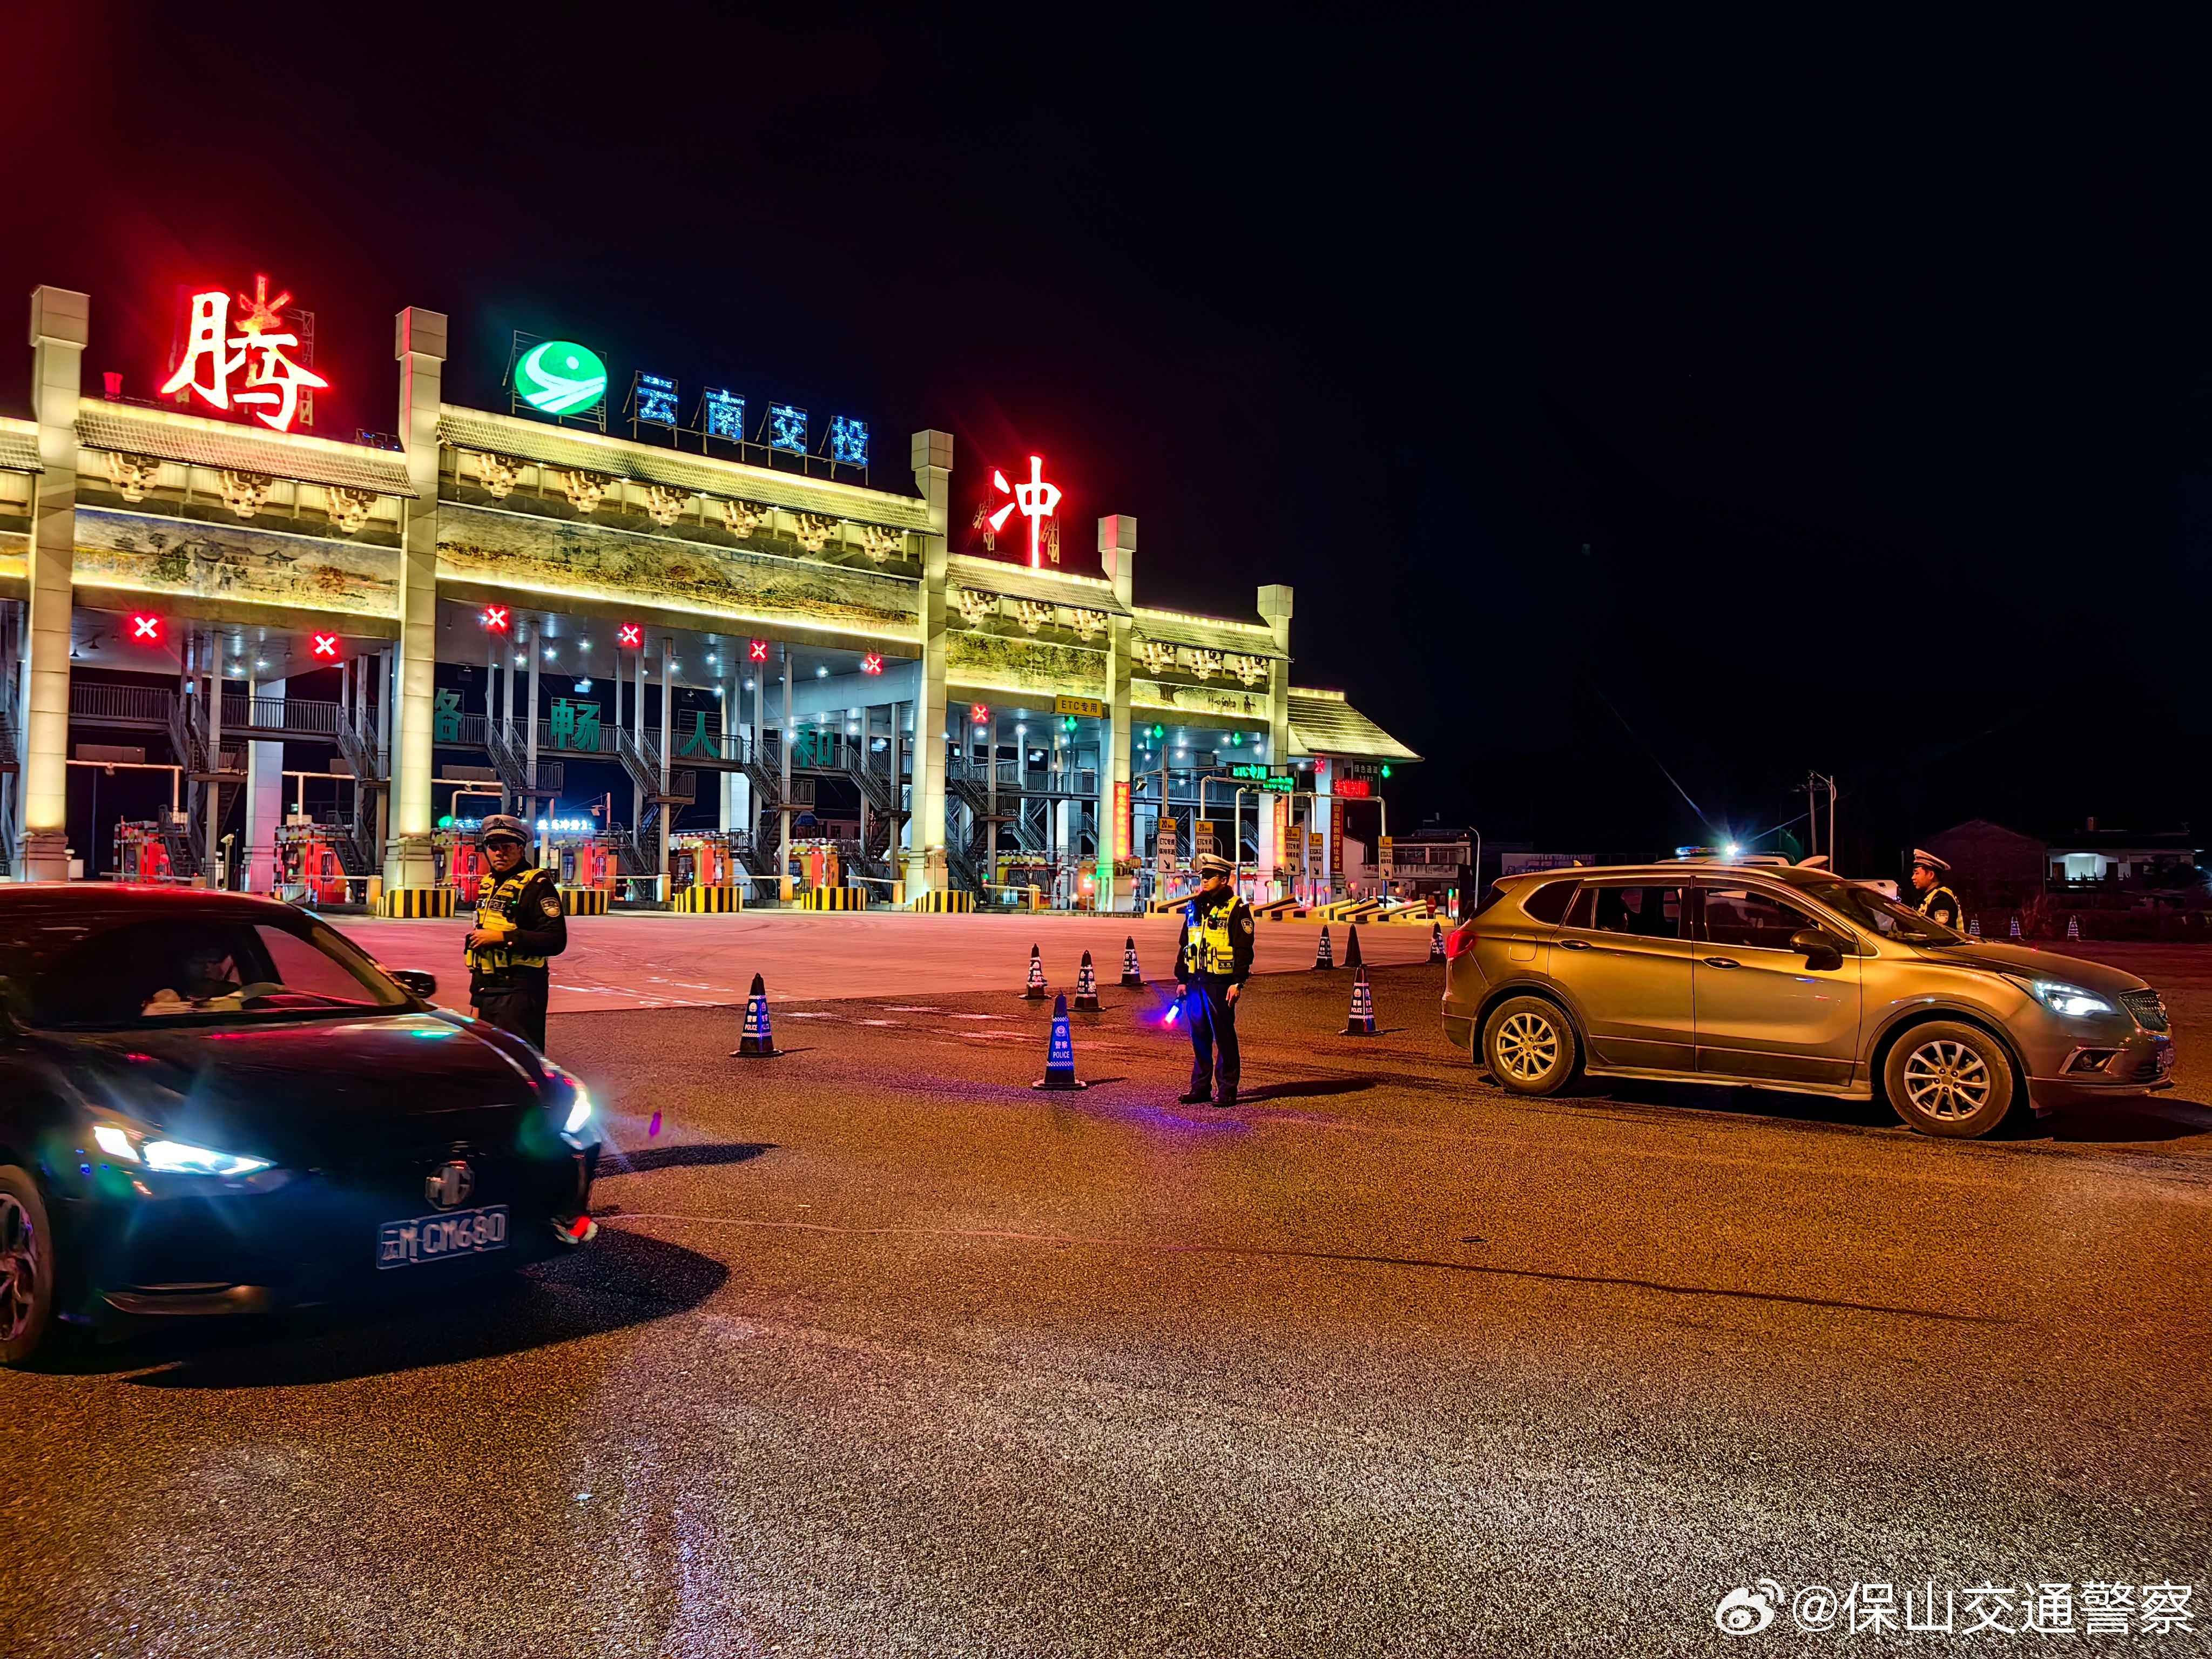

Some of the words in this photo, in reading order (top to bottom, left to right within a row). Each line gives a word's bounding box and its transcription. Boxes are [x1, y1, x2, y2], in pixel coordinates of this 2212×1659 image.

[161, 274, 329, 432] 腾
[636, 374, 868, 466] 云南交投
[989, 456, 1062, 568] 冲
[1061, 700, 1097, 713] ETC专用
[1233, 764, 1266, 779] ETC专用
[1055, 1041, 1068, 1049] 警察
